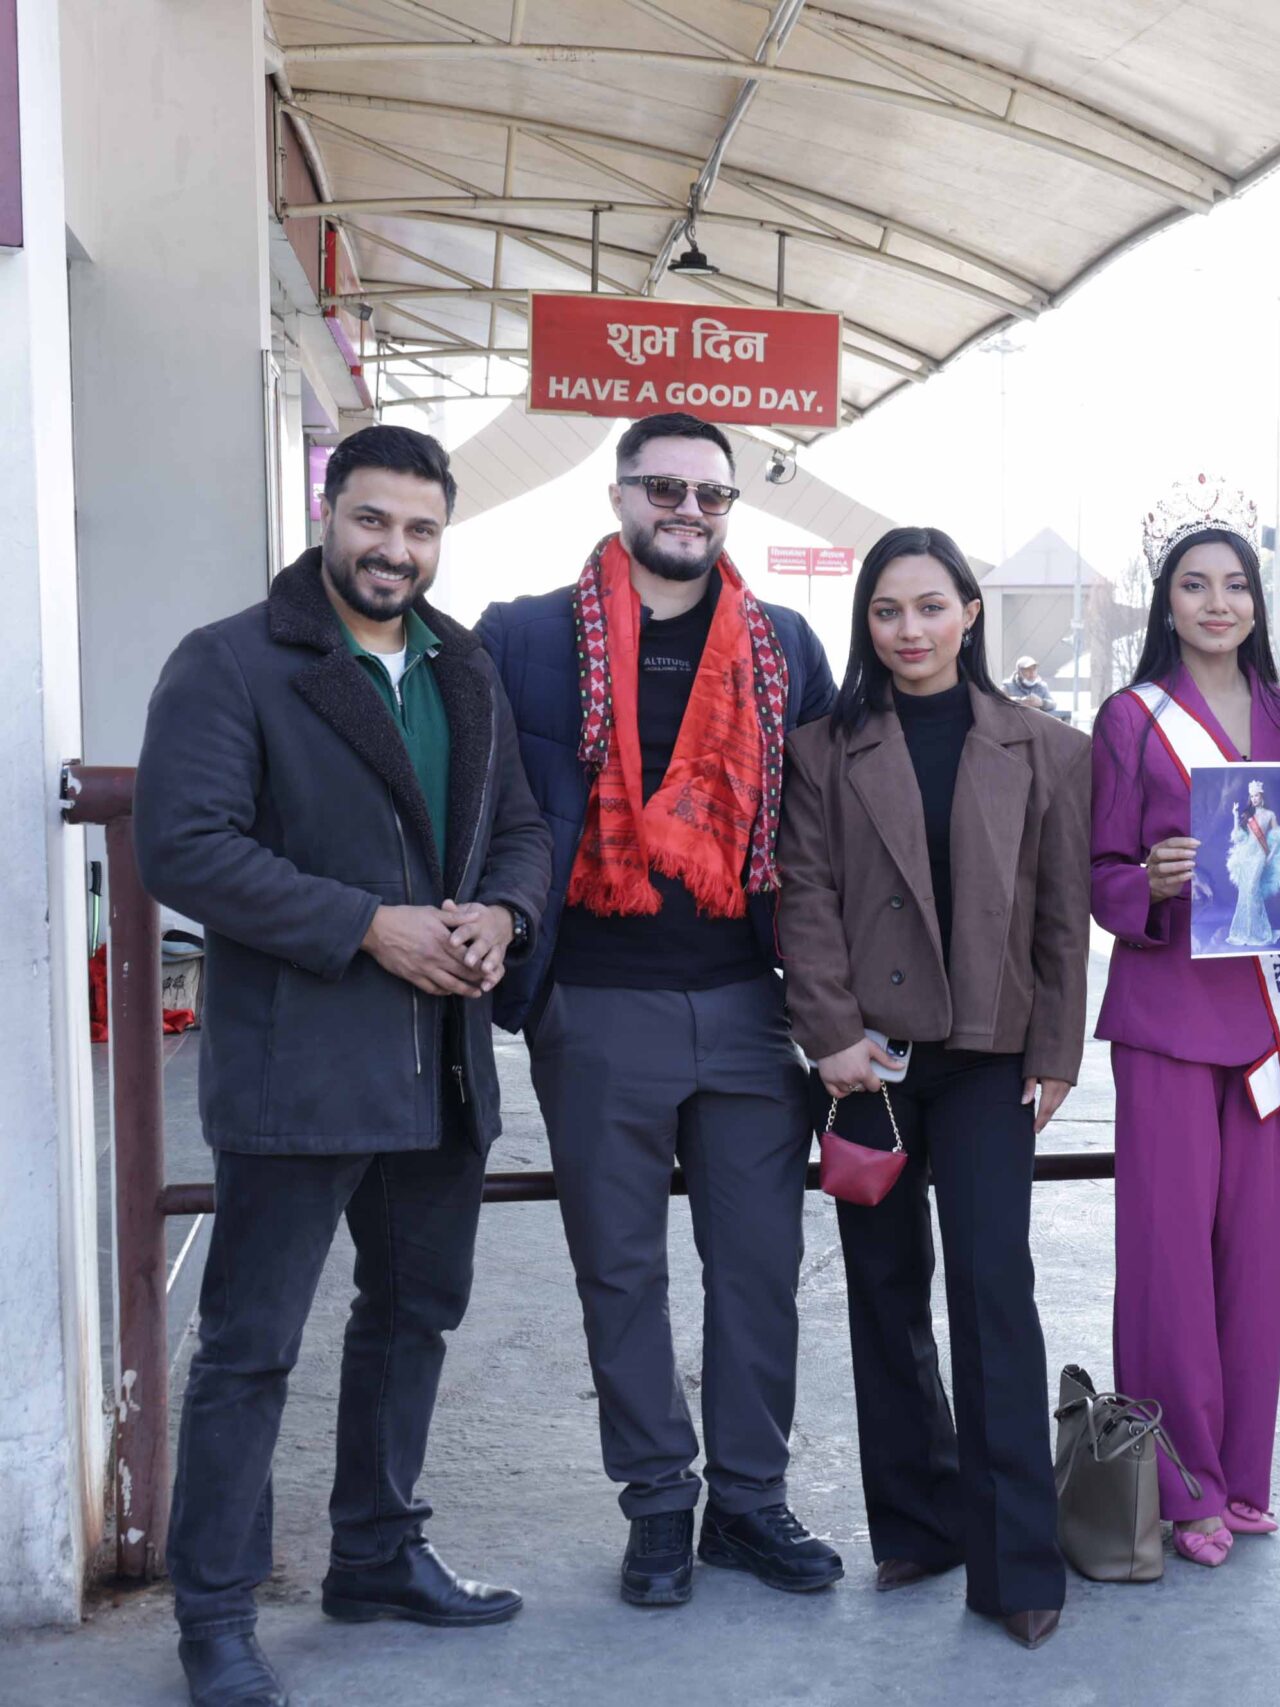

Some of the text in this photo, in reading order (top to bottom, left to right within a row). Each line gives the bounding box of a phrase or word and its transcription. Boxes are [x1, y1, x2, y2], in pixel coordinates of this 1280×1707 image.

[607, 317, 768, 366] शुभ दिन
[548, 376, 823, 414] HAVE A GOOD DAY.
[643, 656, 691, 668] ALTITUDE
